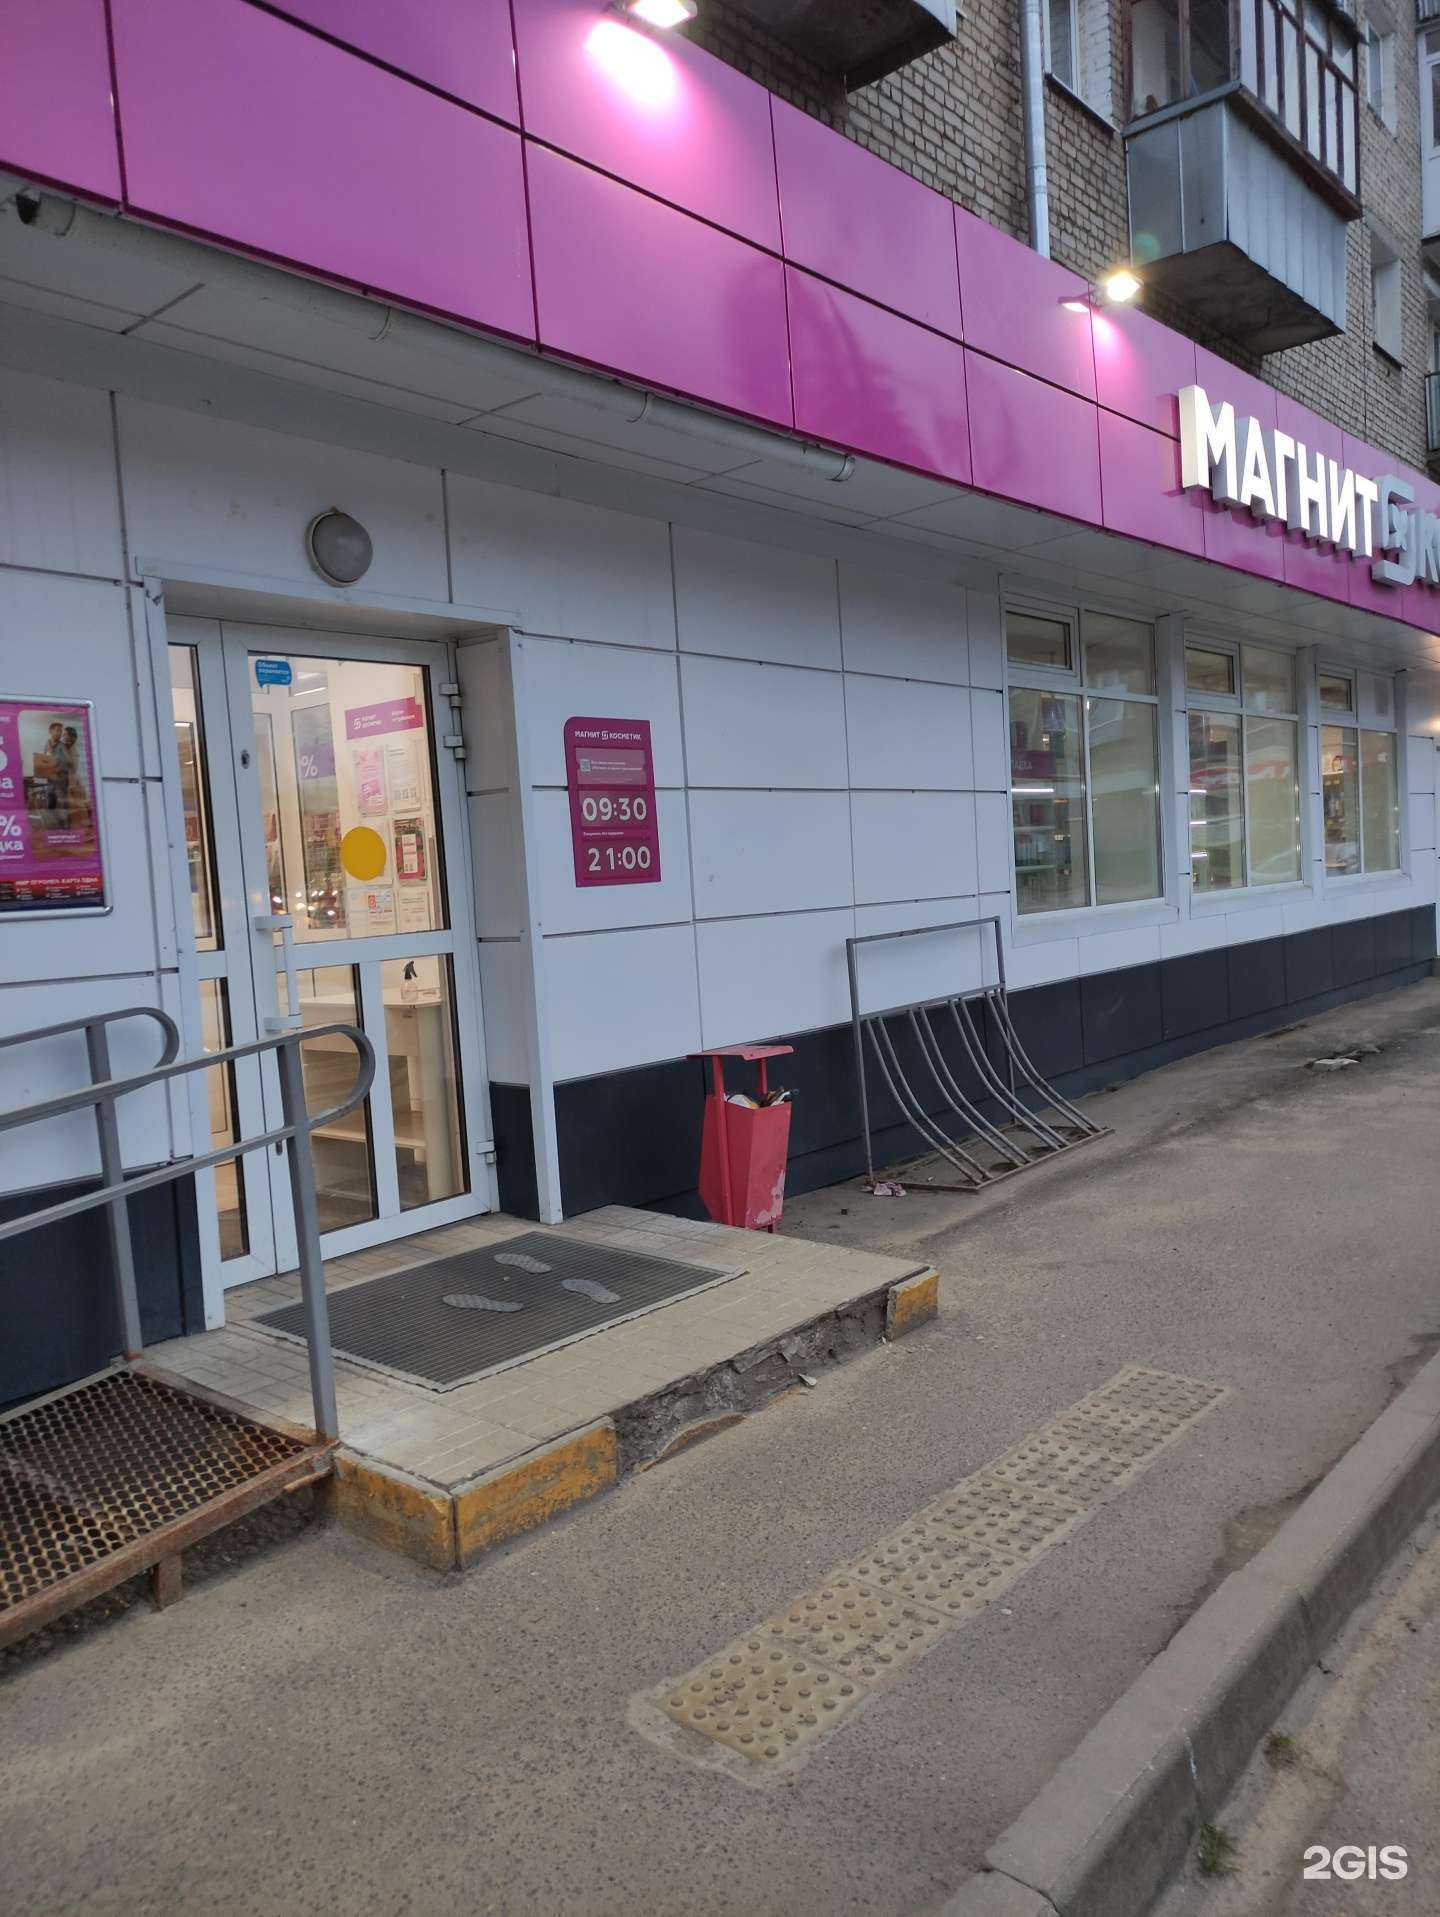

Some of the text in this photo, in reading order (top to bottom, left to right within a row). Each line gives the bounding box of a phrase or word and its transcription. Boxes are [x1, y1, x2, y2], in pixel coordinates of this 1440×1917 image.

[1178, 384, 1379, 558] МАГНИТ
[574, 730, 642, 741] МАГНИТ КОСМЕТИК
[300, 754, 318, 778] %
[582, 797, 647, 822] 09:30
[588, 846, 651, 872] 21:00
